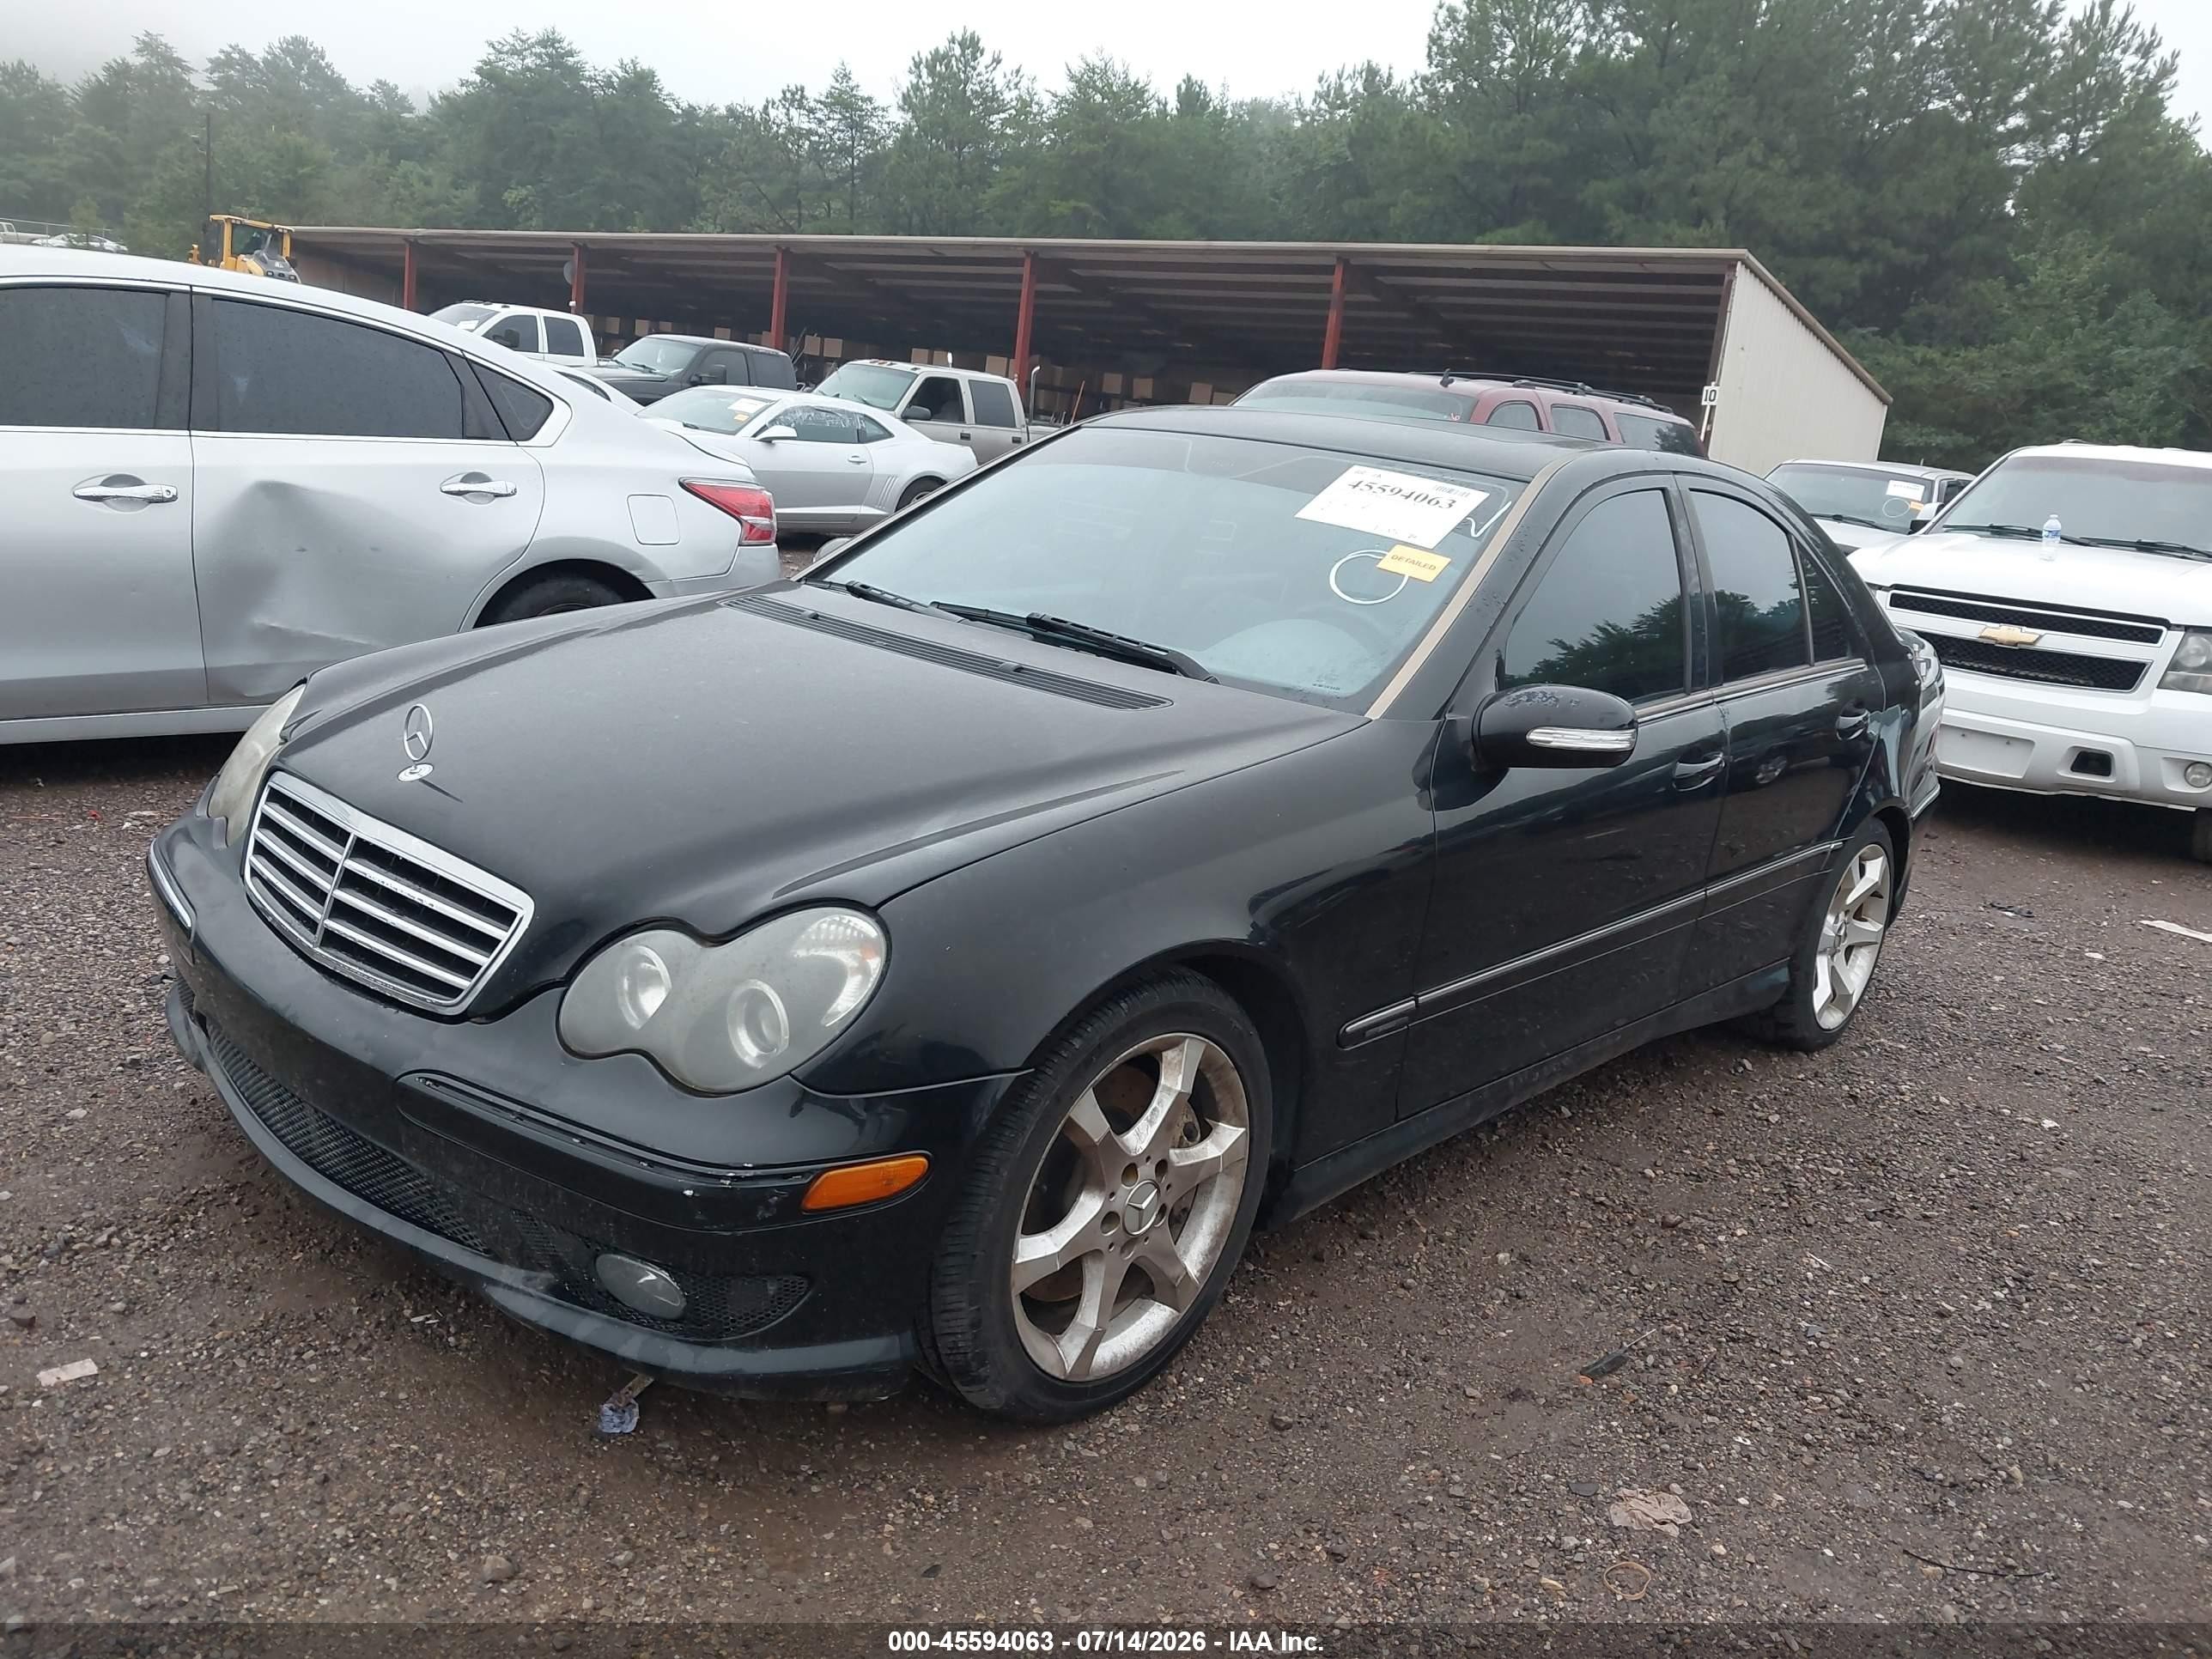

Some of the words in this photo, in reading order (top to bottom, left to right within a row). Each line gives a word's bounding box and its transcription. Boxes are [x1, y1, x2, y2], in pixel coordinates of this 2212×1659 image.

[1704, 389, 1717, 402] 10
[1347, 480, 1457, 509] 45594063
[1390, 554, 1437, 571] DETAILED
